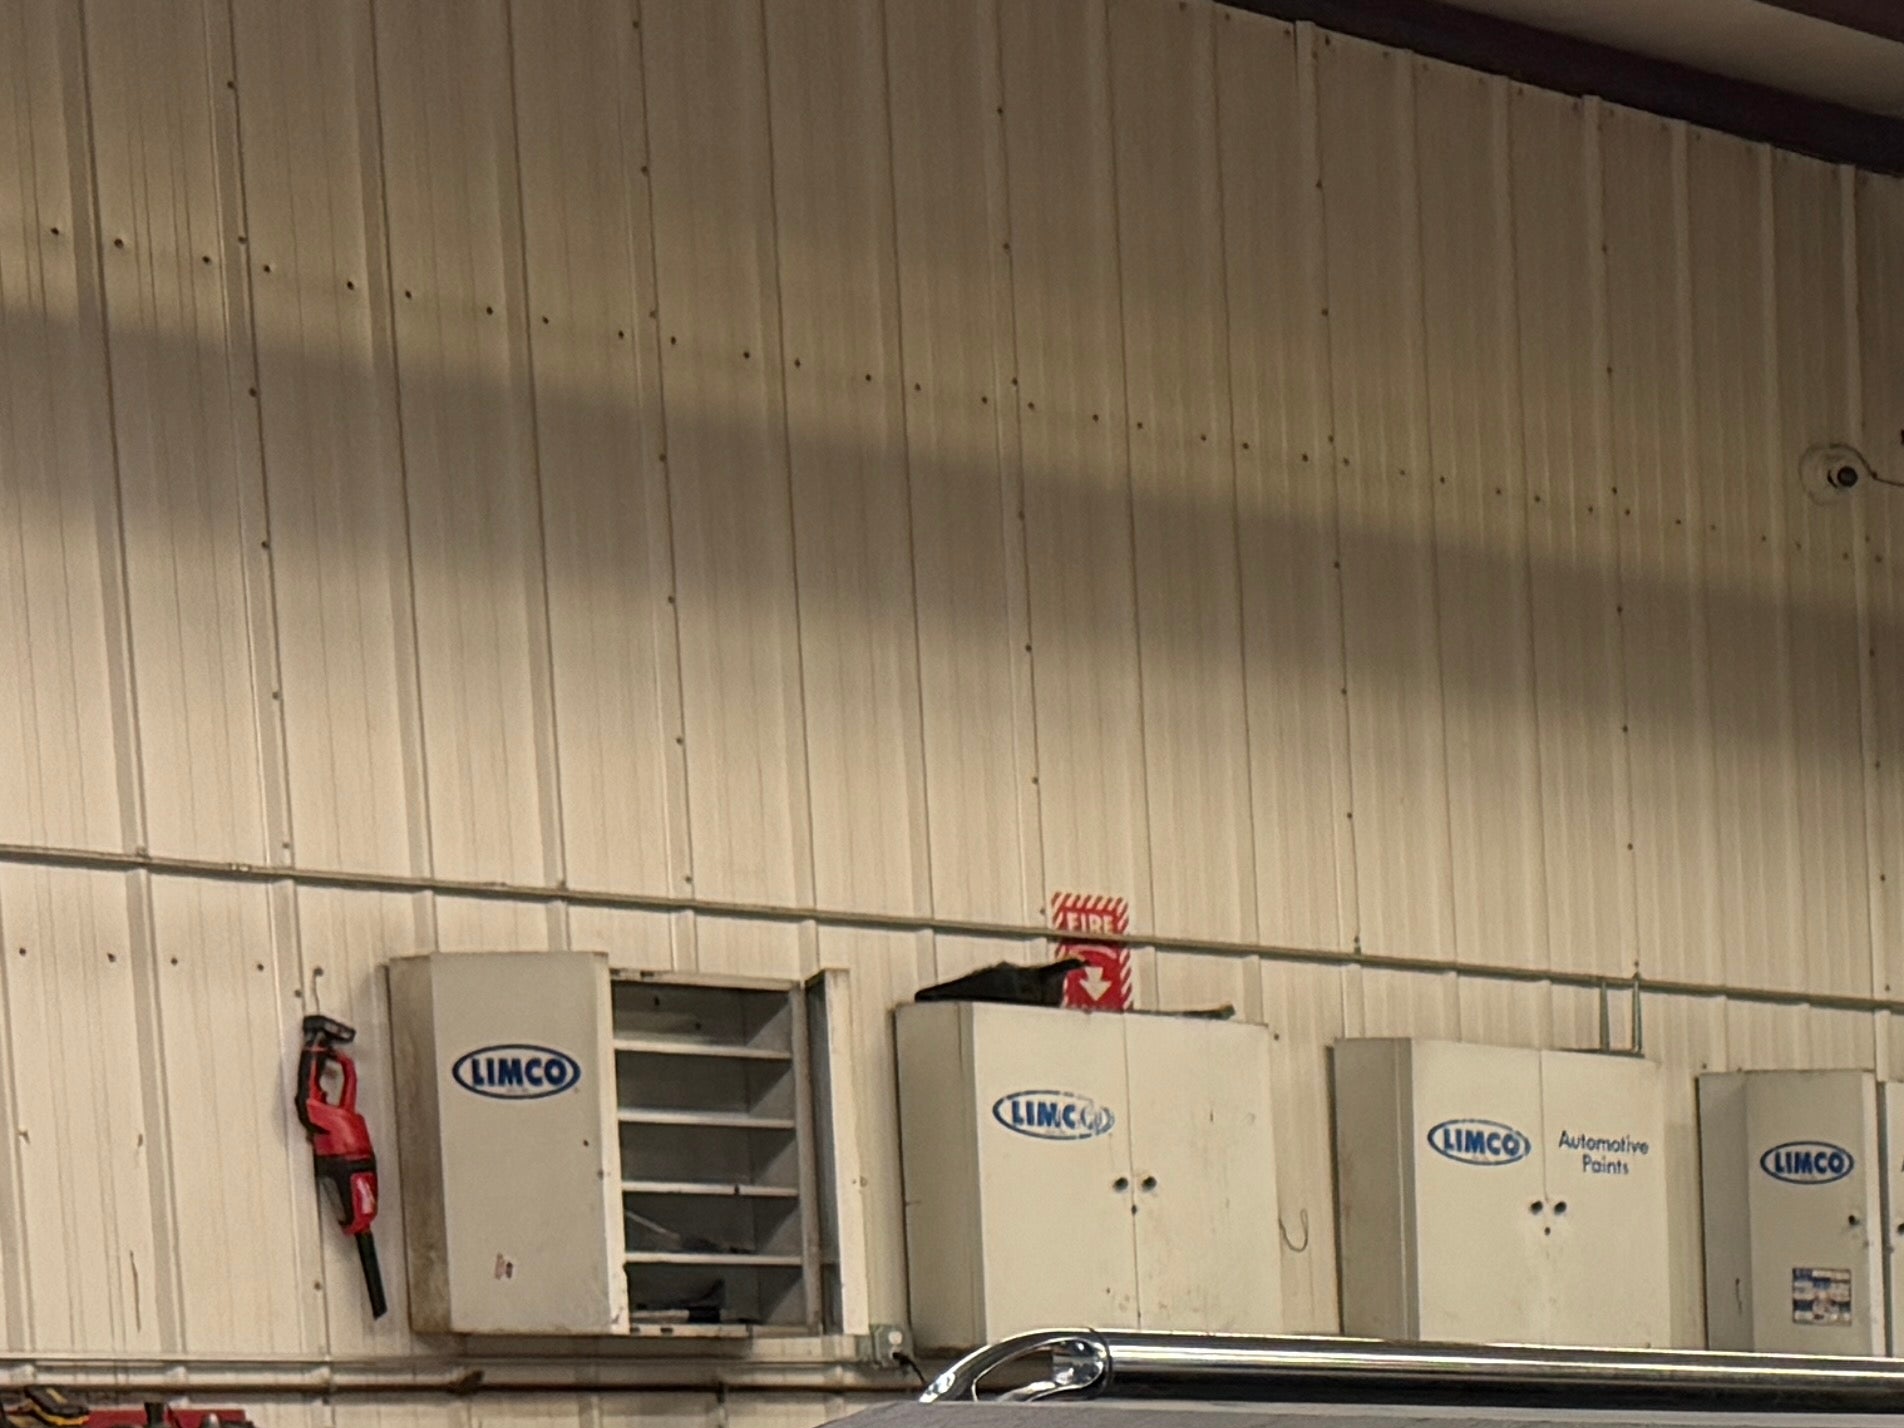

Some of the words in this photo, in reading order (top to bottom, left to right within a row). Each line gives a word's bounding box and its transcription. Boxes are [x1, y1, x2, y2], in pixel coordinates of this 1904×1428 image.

[1066, 911, 1113, 932] FIRE
[471, 1057, 568, 1087] LIMCO
[1443, 1127, 1520, 1157] LIMCO
[1558, 1130, 1649, 1155] Automotive
[1582, 1154, 1629, 1175] Paints
[1774, 1151, 1845, 1174] LIMCO
